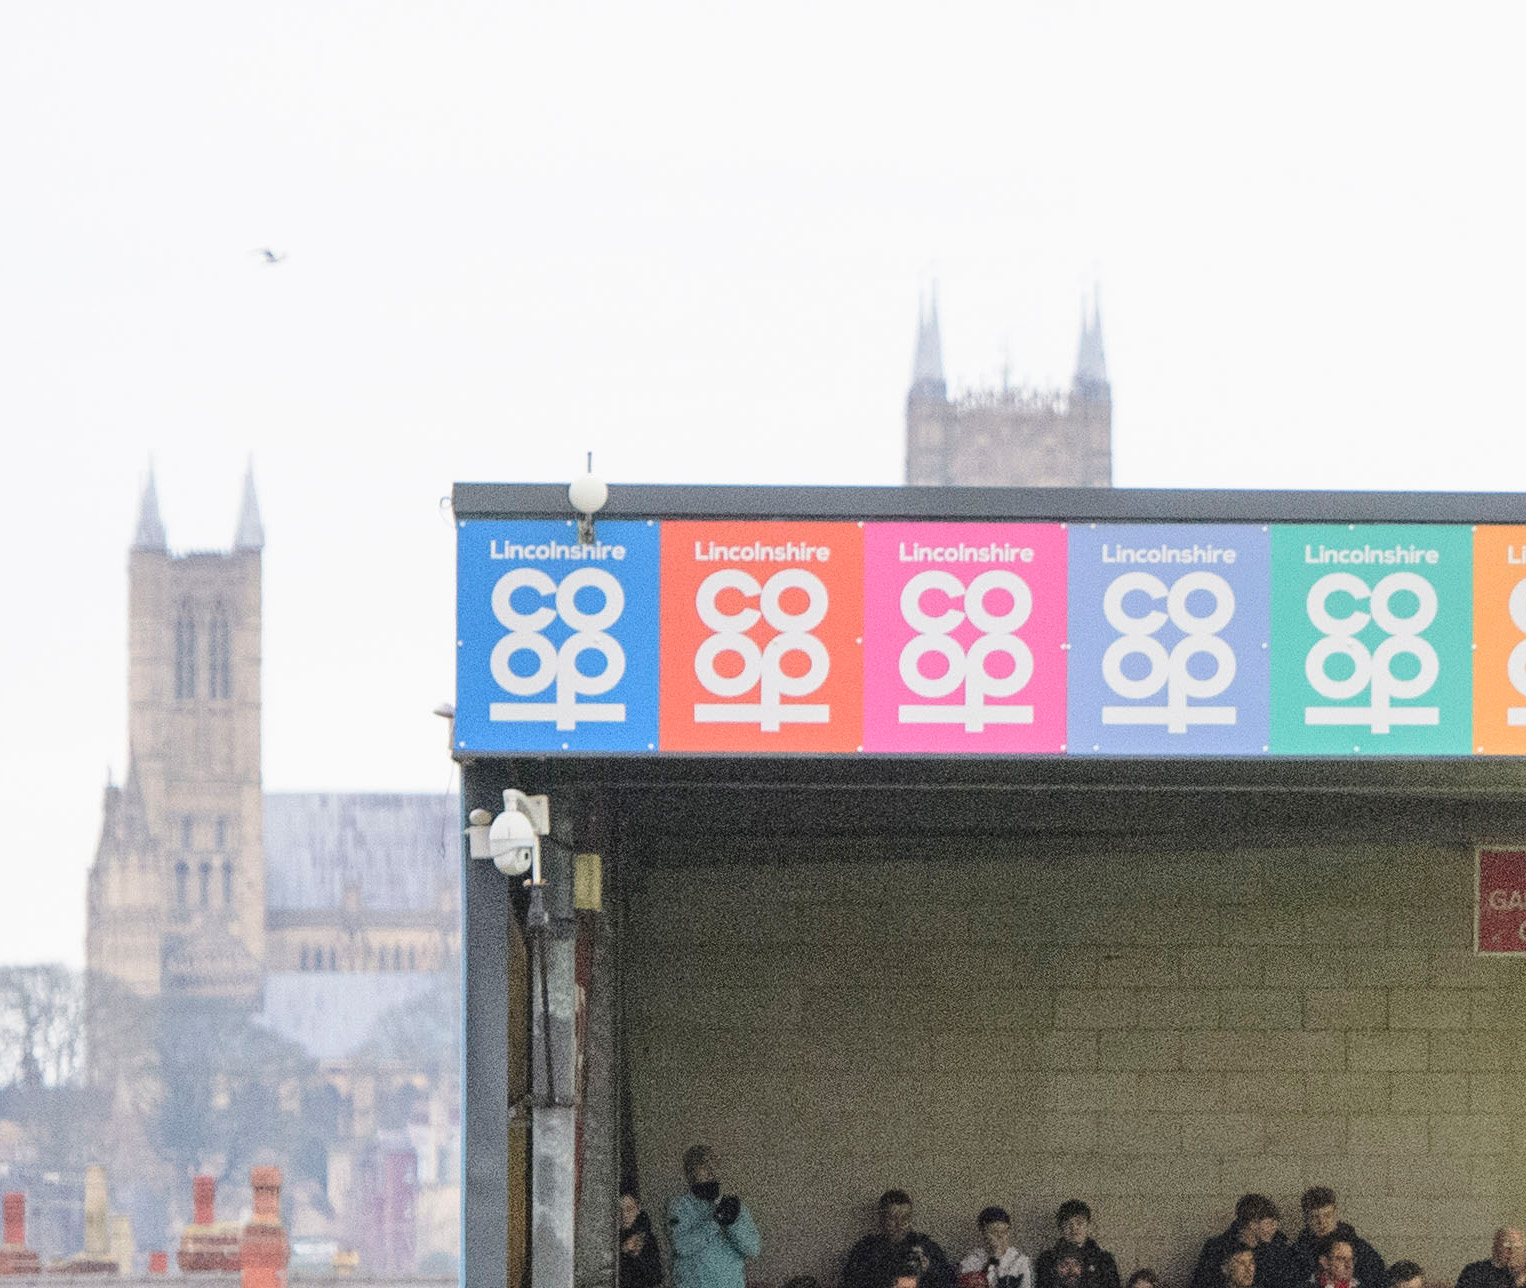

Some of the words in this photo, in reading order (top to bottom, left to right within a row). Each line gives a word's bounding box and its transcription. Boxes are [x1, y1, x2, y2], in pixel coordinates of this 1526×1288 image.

[490, 541, 626, 562] Lincolnshire
[694, 542, 830, 563] Lincolnshire
[898, 543, 1034, 564] Lincolnshire
[1101, 543, 1238, 564] Lincolnshire
[1304, 545, 1440, 565] Lincolnshire
